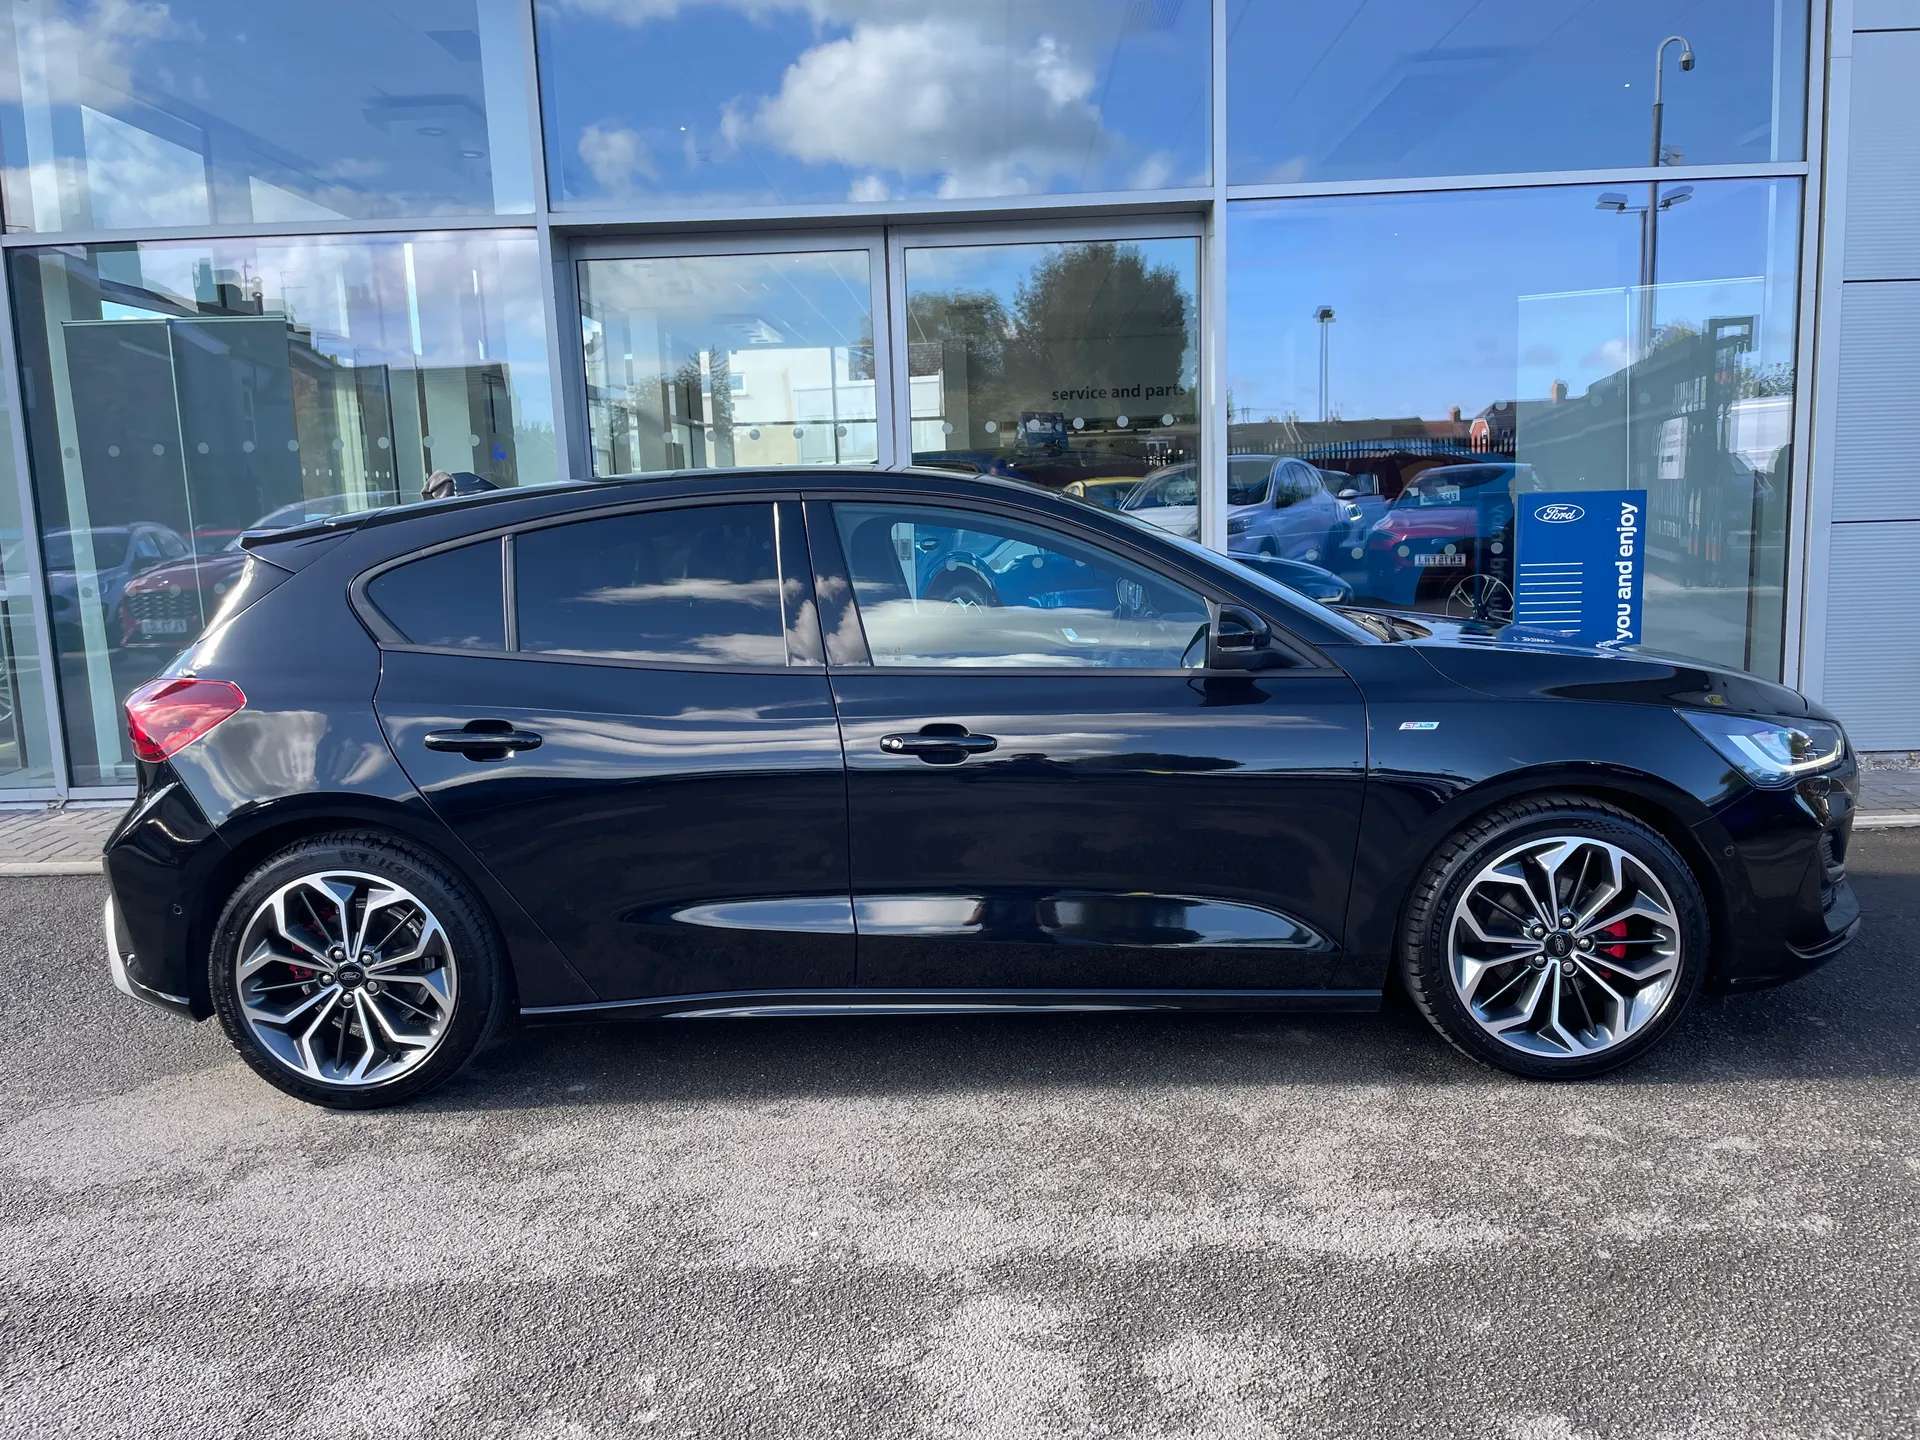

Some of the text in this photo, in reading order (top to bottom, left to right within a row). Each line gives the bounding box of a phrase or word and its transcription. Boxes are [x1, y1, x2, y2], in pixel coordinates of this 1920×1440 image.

[1052, 383, 1186, 401] service and parts
[1541, 506, 1576, 520] Ford
[1614, 502, 1638, 640] you and enjoy
